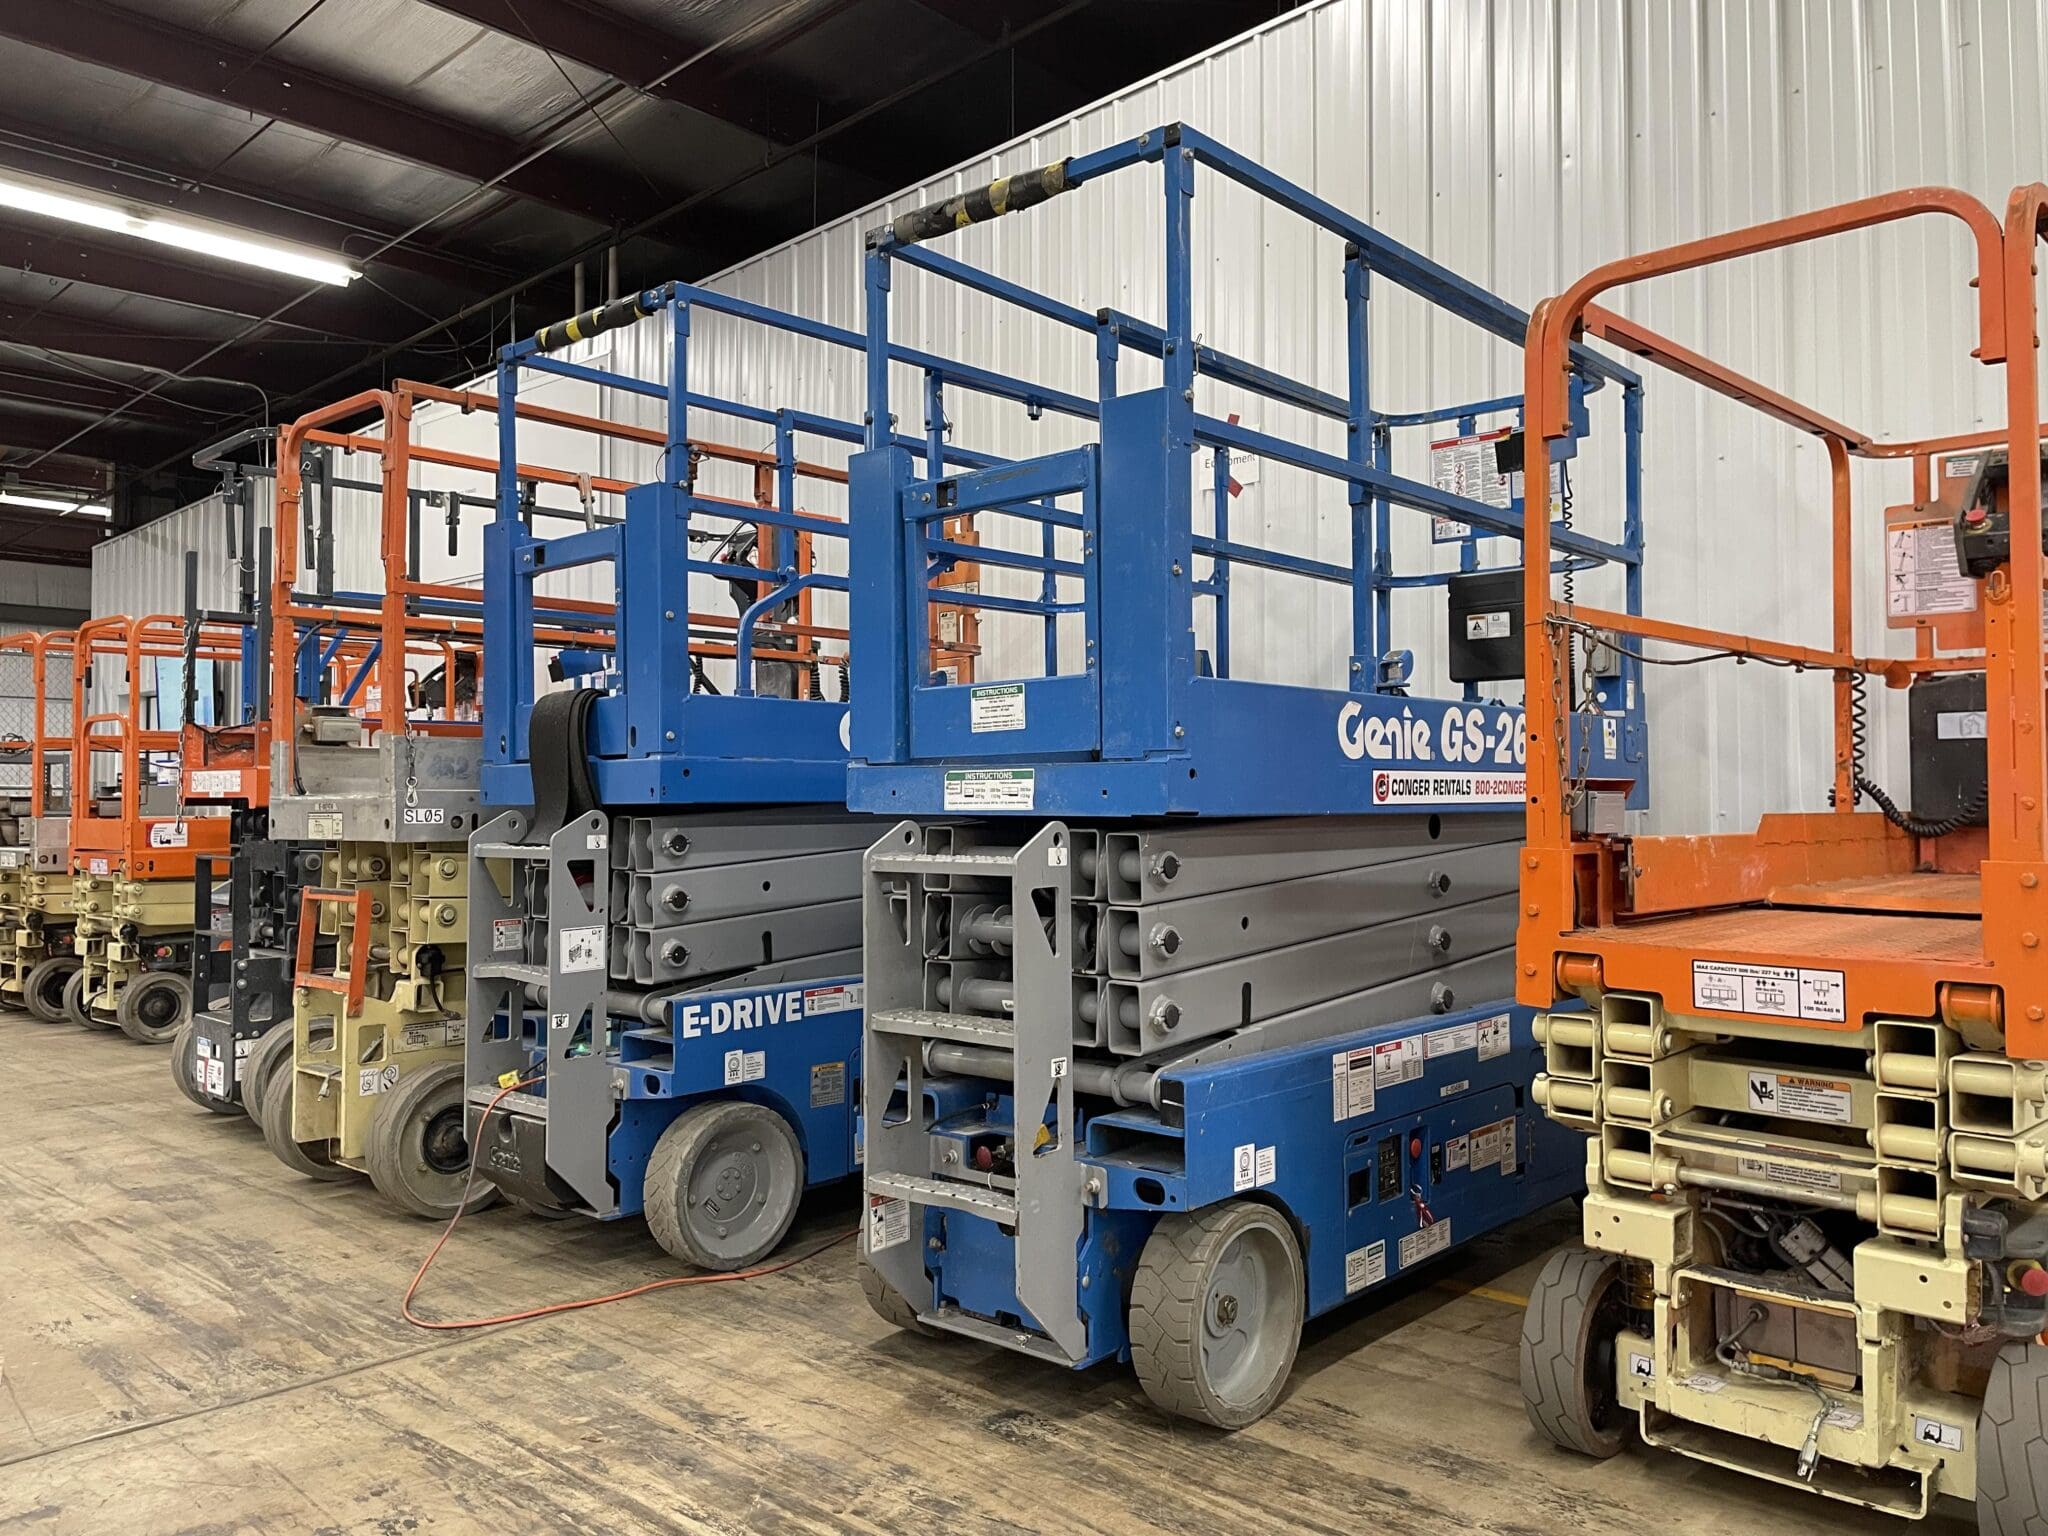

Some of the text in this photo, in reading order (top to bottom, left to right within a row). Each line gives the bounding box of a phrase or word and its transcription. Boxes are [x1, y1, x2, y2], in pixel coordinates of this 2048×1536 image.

[1205, 453, 1256, 469] Ement
[1337, 700, 1432, 760] Genie
[964, 771, 1013, 780] INSTRUCTIONS
[1391, 778, 1430, 796] CONGER
[1432, 778, 1472, 796] RENTALS
[1709, 965, 1737, 973] CAPACITY
[683, 991, 802, 1039] E-DRIVE
[1797, 1078, 1834, 1089] WARNING
